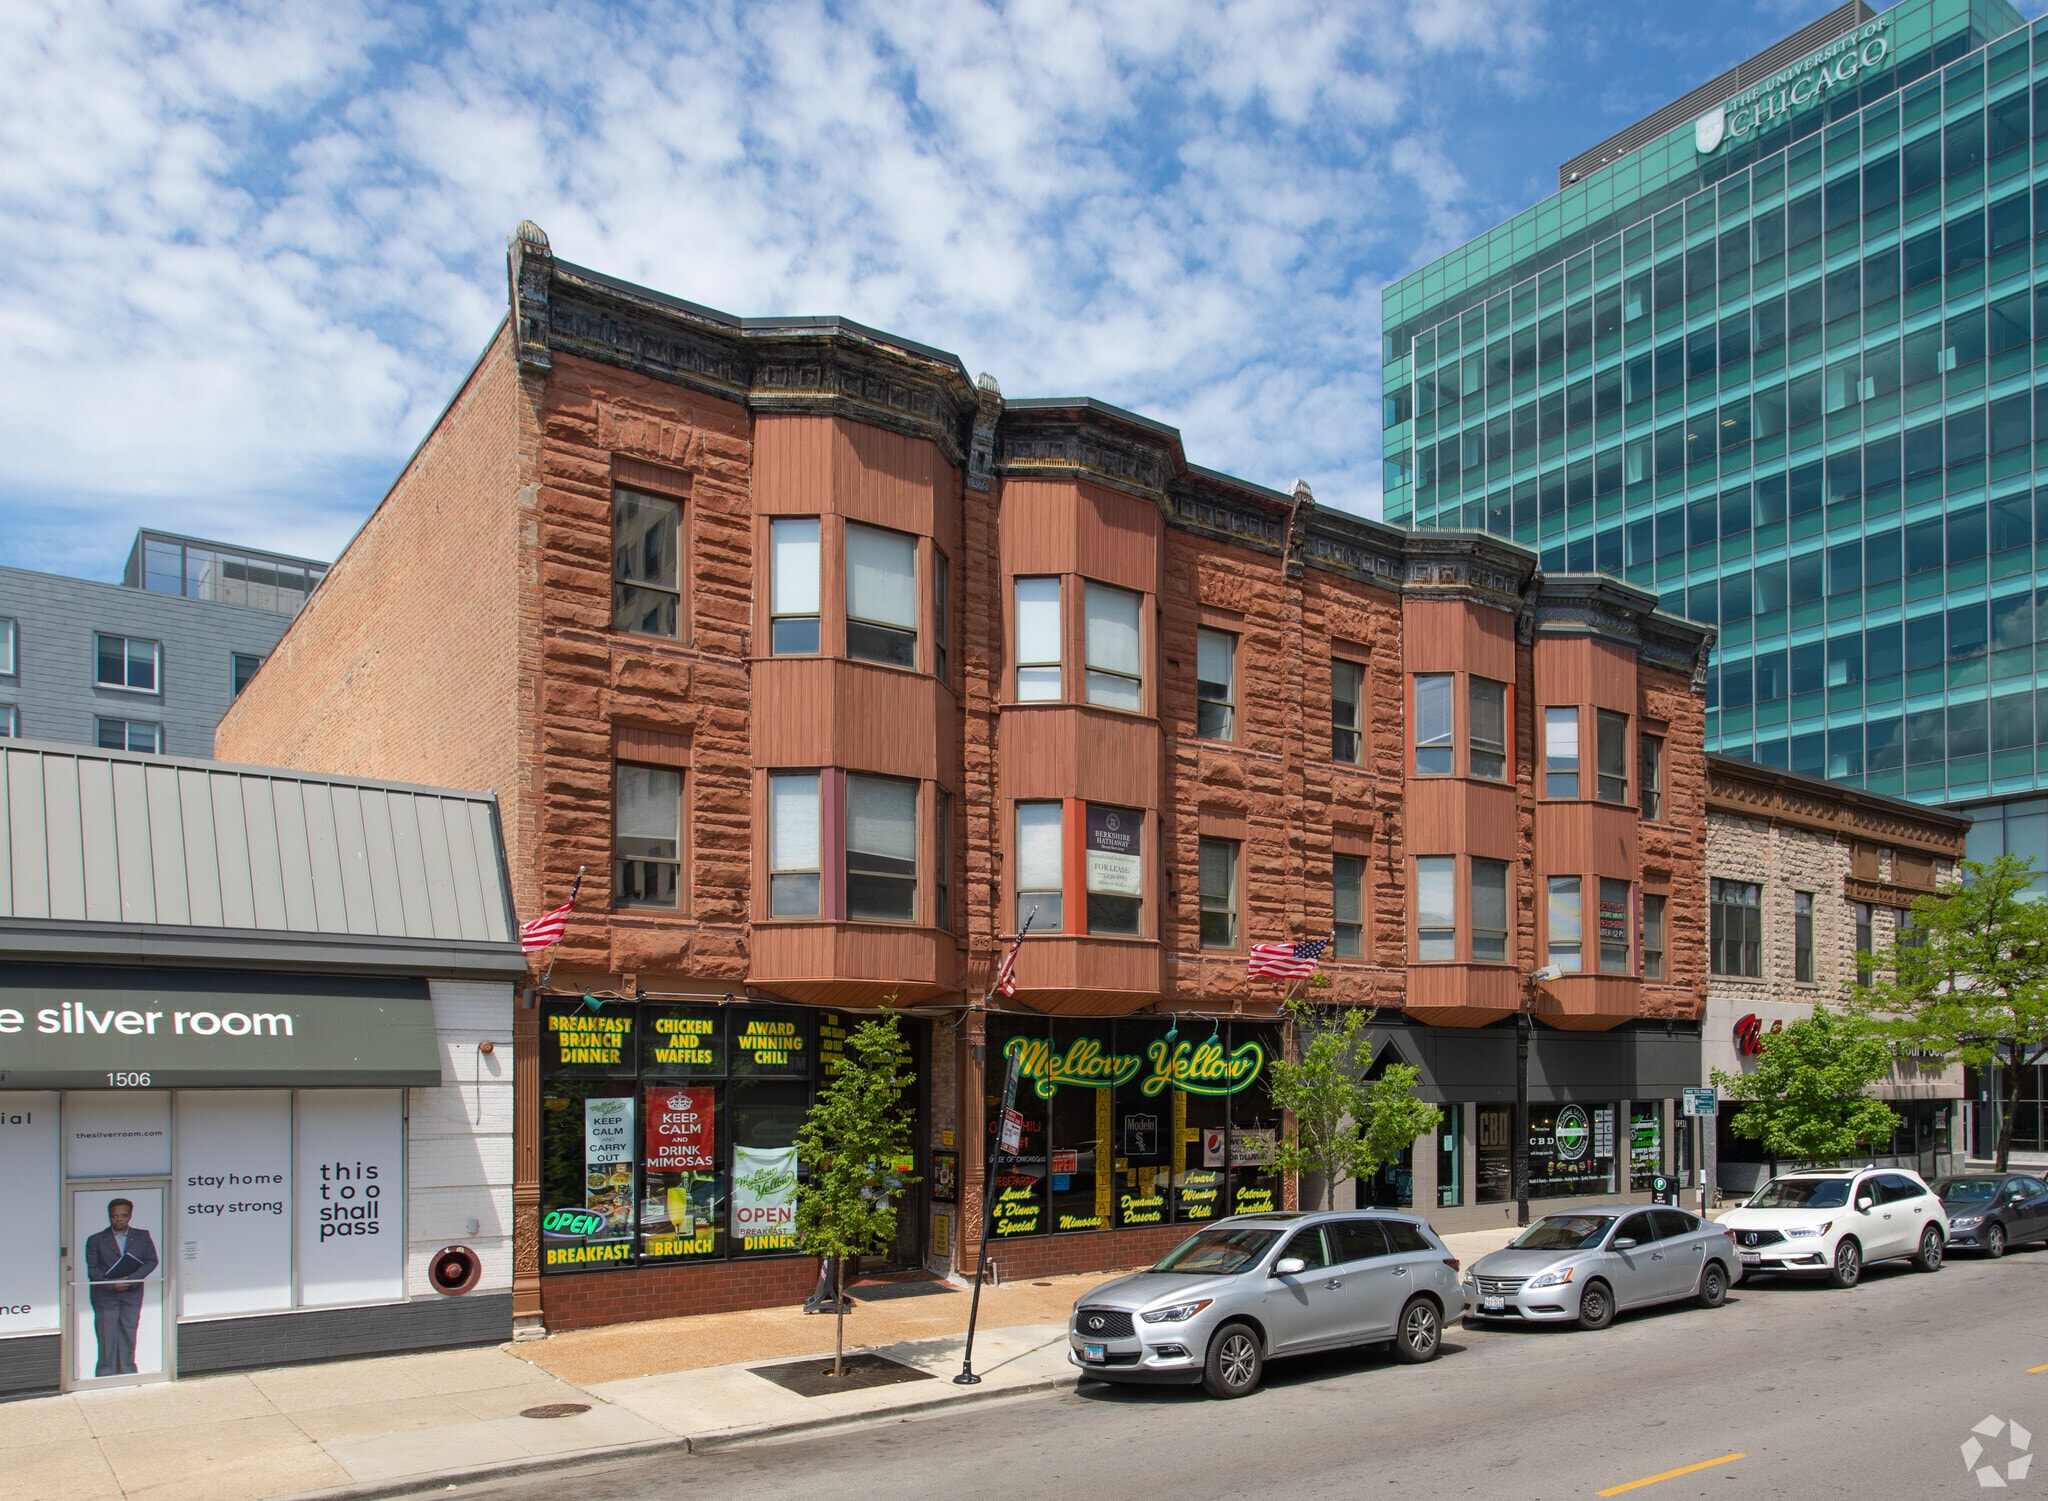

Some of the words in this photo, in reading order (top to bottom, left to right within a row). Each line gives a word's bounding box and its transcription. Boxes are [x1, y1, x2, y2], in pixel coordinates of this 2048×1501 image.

[1731, 92, 1760, 111] THE
[1766, 33, 1858, 90] UNIVERSITY
[1864, 18, 1888, 37] OF
[1731, 37, 1888, 136] CHICAGO
[1095, 830, 1131, 841] BERKSHIRE
[1096, 837, 1130, 848] HATHAWAY
[1094, 863, 1108, 871] FOR
[1109, 865, 1130, 874] LEASE
[36, 1002, 163, 1035] silver
[174, 1010, 293, 1037] room
[548, 1016, 632, 1033] BREAKFAST
[655, 1018, 713, 1034] CHICKEN
[746, 1021, 796, 1036] AWARD
[559, 1032, 623, 1048] BRUNCH
[668, 1034, 699, 1048] AND
[738, 1036, 803, 1050] WINNING
[560, 1048, 621, 1063] DINNER
[655, 1049, 713, 1064] WAFFLES
[754, 1051, 788, 1064] CHILI
[1003, 1036, 1141, 1099] Mellow
[1141, 1040, 1265, 1096] Yellow
[107, 1072, 151, 1087] 1506
[594, 1117, 623, 1126] KEEP
[662, 1112, 699, 1124] KEEP
[1127, 1118, 1155, 1131] Modelo
[76, 1130, 163, 1139] thesilverroom.com
[592, 1127, 624, 1136] CALM
[658, 1123, 702, 1135] CALM
[1480, 1112, 1508, 1146] CBD
[589, 1143, 627, 1153] CARRY
[1529, 1137, 1555, 1145] CBD
[597, 1154, 620, 1162] OUT
[659, 1145, 701, 1157] DRINK
[647, 1155, 713, 1168] MIMOSAS
[320, 1161, 379, 1181] this
[1185, 1171, 1216, 1185] Award
[188, 1173, 225, 1188] stay
[229, 1172, 283, 1186] home
[320, 1182, 381, 1200] too
[1000, 1185, 1032, 1201] Lunch
[1182, 1188, 1218, 1201] Winning
[1236, 1186, 1272, 1200] Catering
[188, 1201, 225, 1216] stay
[228, 1199, 283, 1215] strong
[1121, 1194, 1163, 1209] Dynamite
[1235, 1200, 1274, 1215] Available
[320, 1201, 379, 1221] shall
[736, 1206, 792, 1223] OPEN
[993, 1204, 1003, 1217] &
[1005, 1202, 1040, 1217] Dinner
[1124, 1210, 1161, 1224] Desserts
[1189, 1204, 1212, 1219] Chili
[543, 1211, 601, 1236] OPEN
[997, 1218, 1037, 1237] Special
[1059, 1214, 1102, 1230] Mimosas
[320, 1219, 380, 1243] pass
[740, 1227, 788, 1235] BREAKFAST
[655, 1239, 714, 1257] BRUNCH
[743, 1234, 796, 1251] DINNER
[547, 1244, 631, 1265] BREAKFAST
